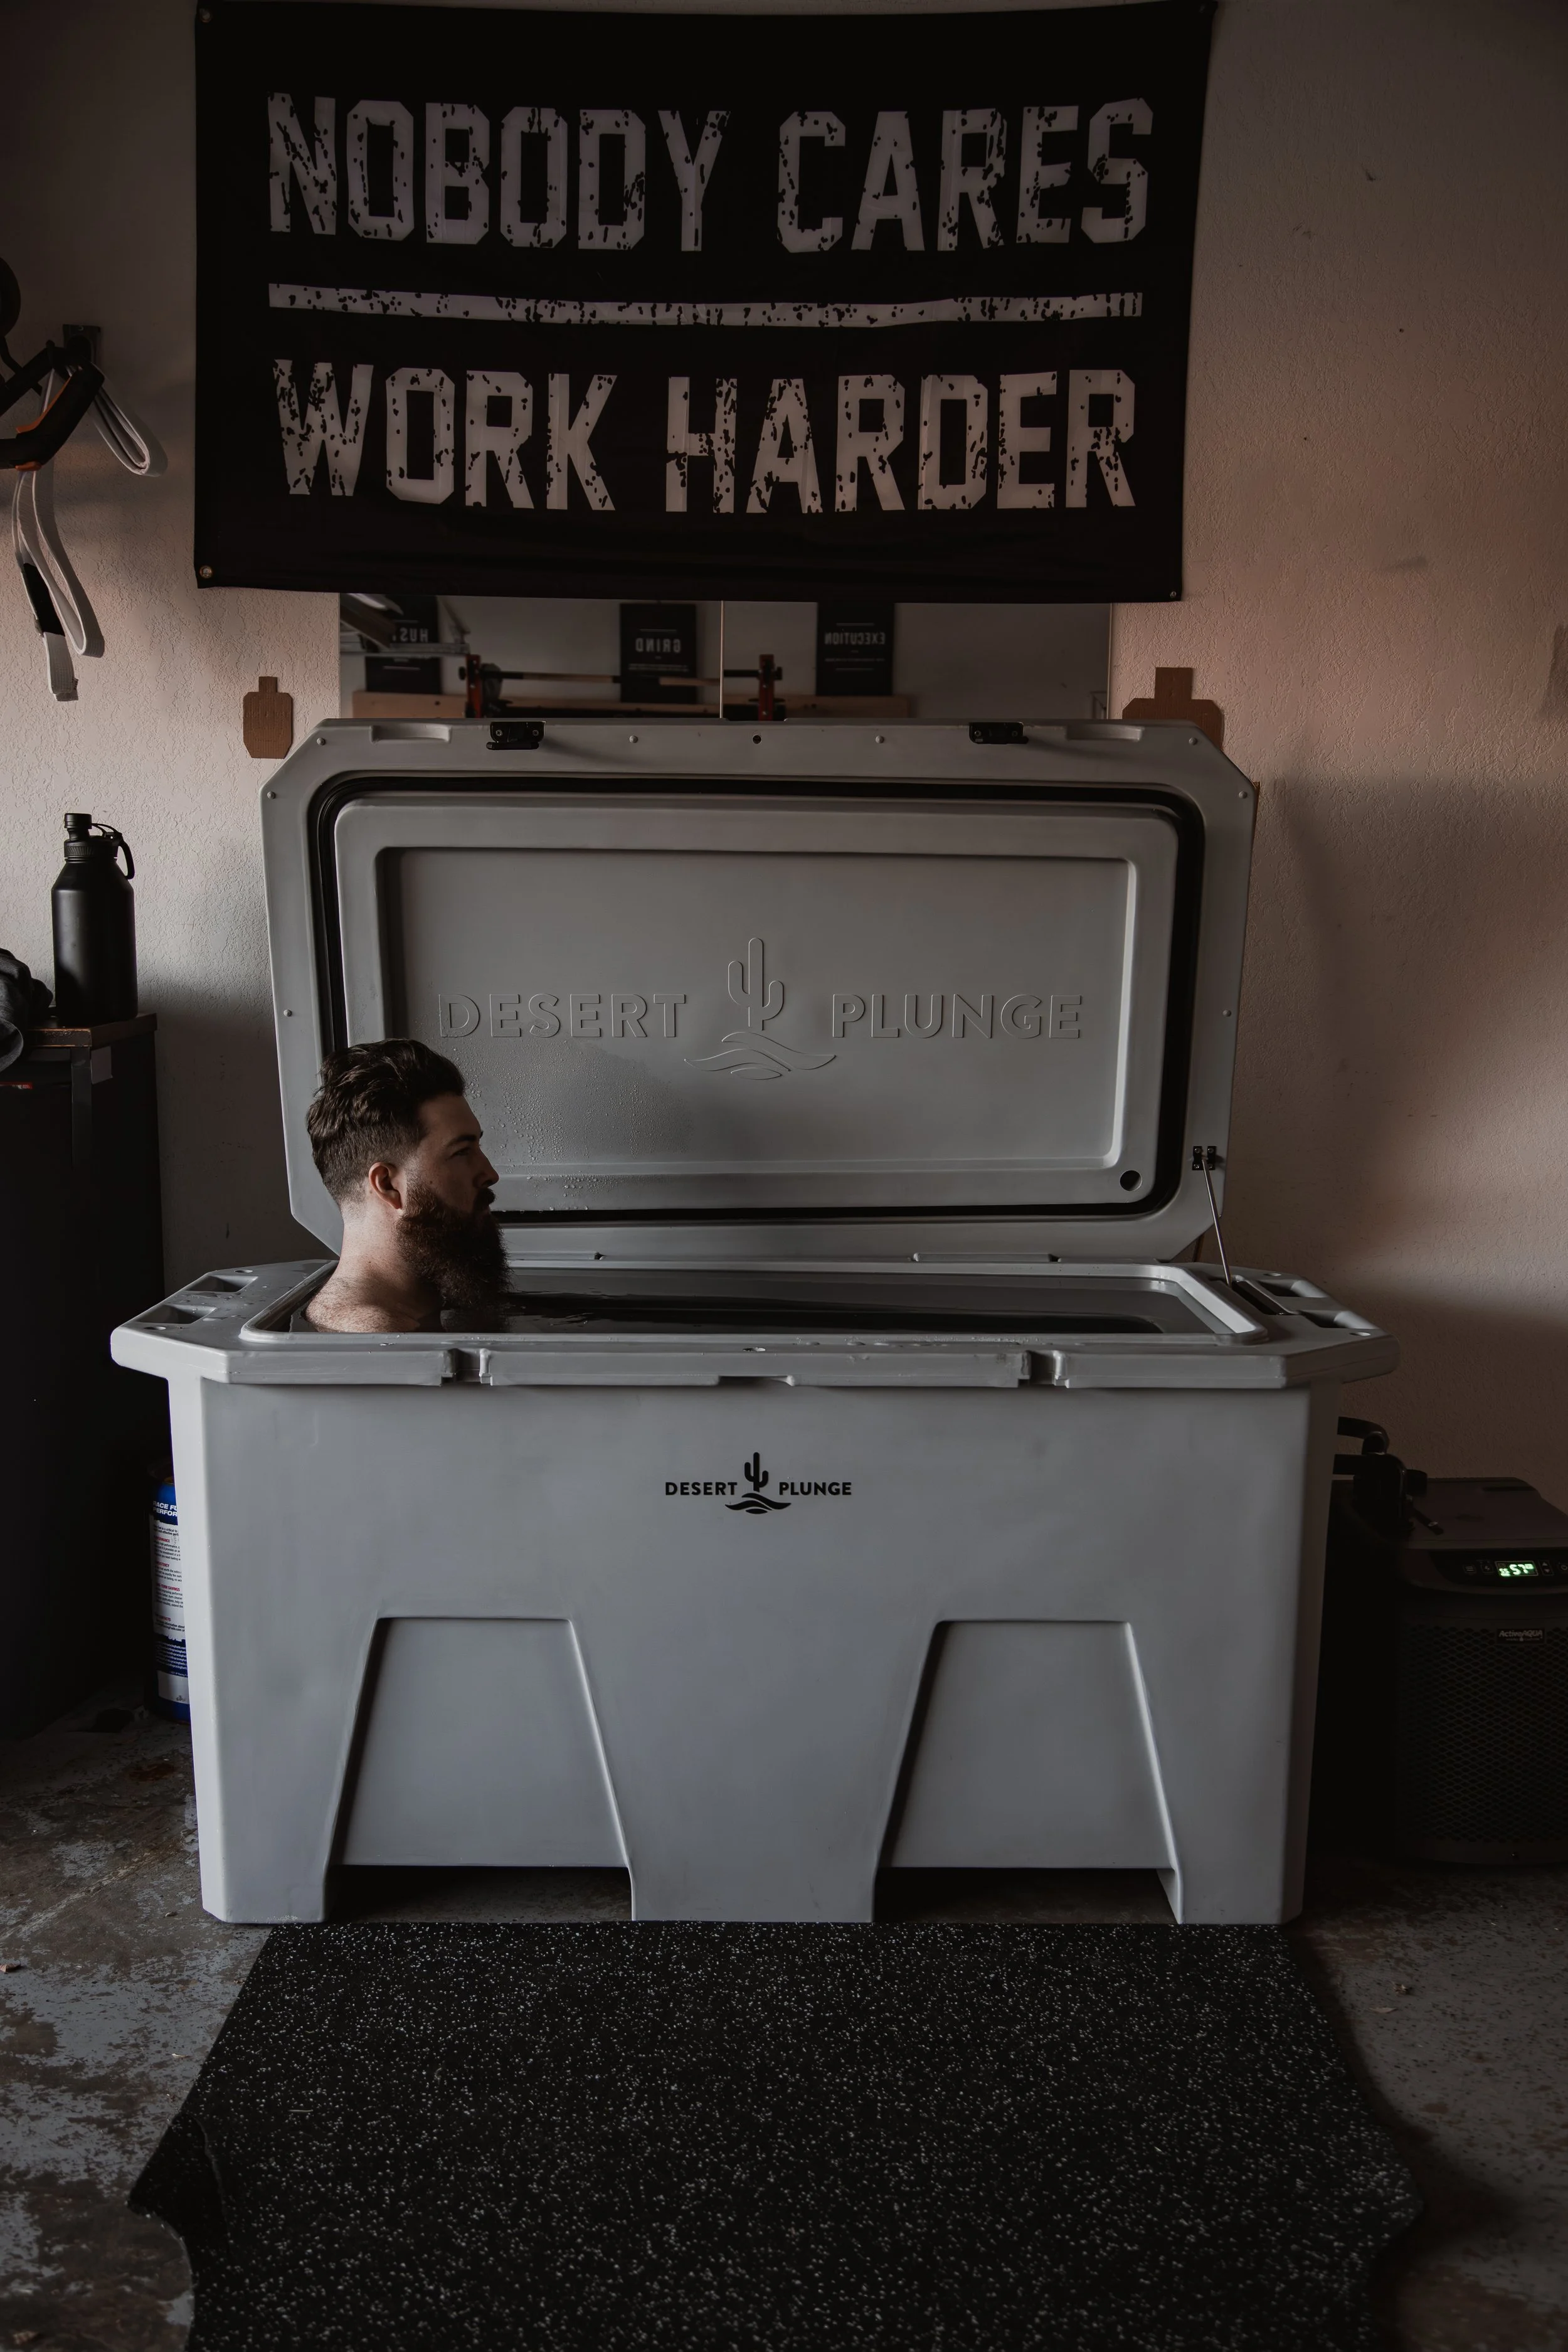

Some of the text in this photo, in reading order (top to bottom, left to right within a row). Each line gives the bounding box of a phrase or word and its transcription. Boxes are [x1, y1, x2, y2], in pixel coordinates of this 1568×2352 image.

[267, 92, 1153, 253] NOBODY CARES
[273, 360, 1135, 513] WORK HARDER
[439, 993, 1082, 1039] DESERT PLUNGE
[665, 1481, 852, 1496] DESERT PLUNGE
[153, 1500, 169, 1509] RACE
[1498, 1629, 1543, 1639] ActiveAQUA
